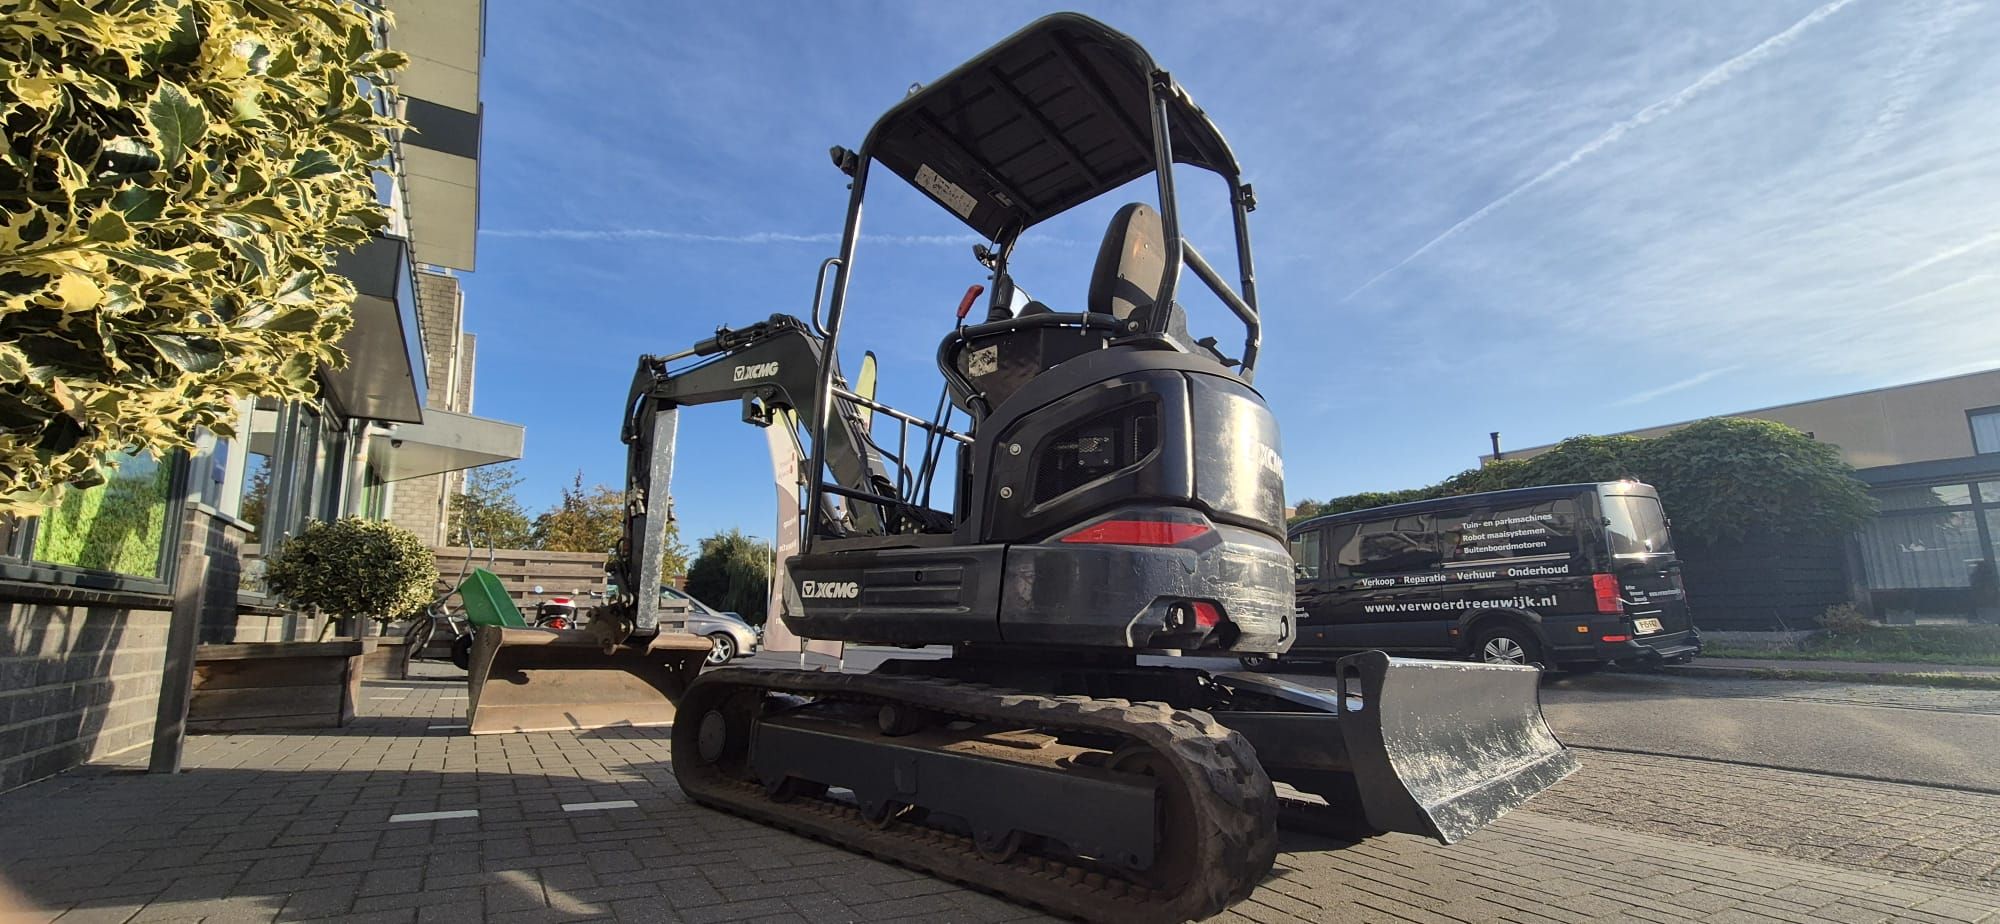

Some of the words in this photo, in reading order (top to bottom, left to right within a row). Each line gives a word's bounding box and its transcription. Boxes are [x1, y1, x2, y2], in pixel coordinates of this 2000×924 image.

[744, 361, 779, 380] XCMG
[1462, 521, 1482, 530] Tuin-
[1495, 513, 1553, 527] parkmachines
[1462, 534, 1486, 542] Robot
[1487, 527, 1546, 540] maaisystemen
[1463, 541, 1547, 554] Buitenboordmotoren
[1362, 578, 1395, 587] Verkoop
[1403, 573, 1447, 585] Reparatie
[1456, 570, 1497, 580] Verhuur
[1507, 564, 1569, 577] Onderhoud
[815, 582, 859, 598] XCMG
[1364, 594, 1558, 613] www.verwoerdreeuwijk.nl
